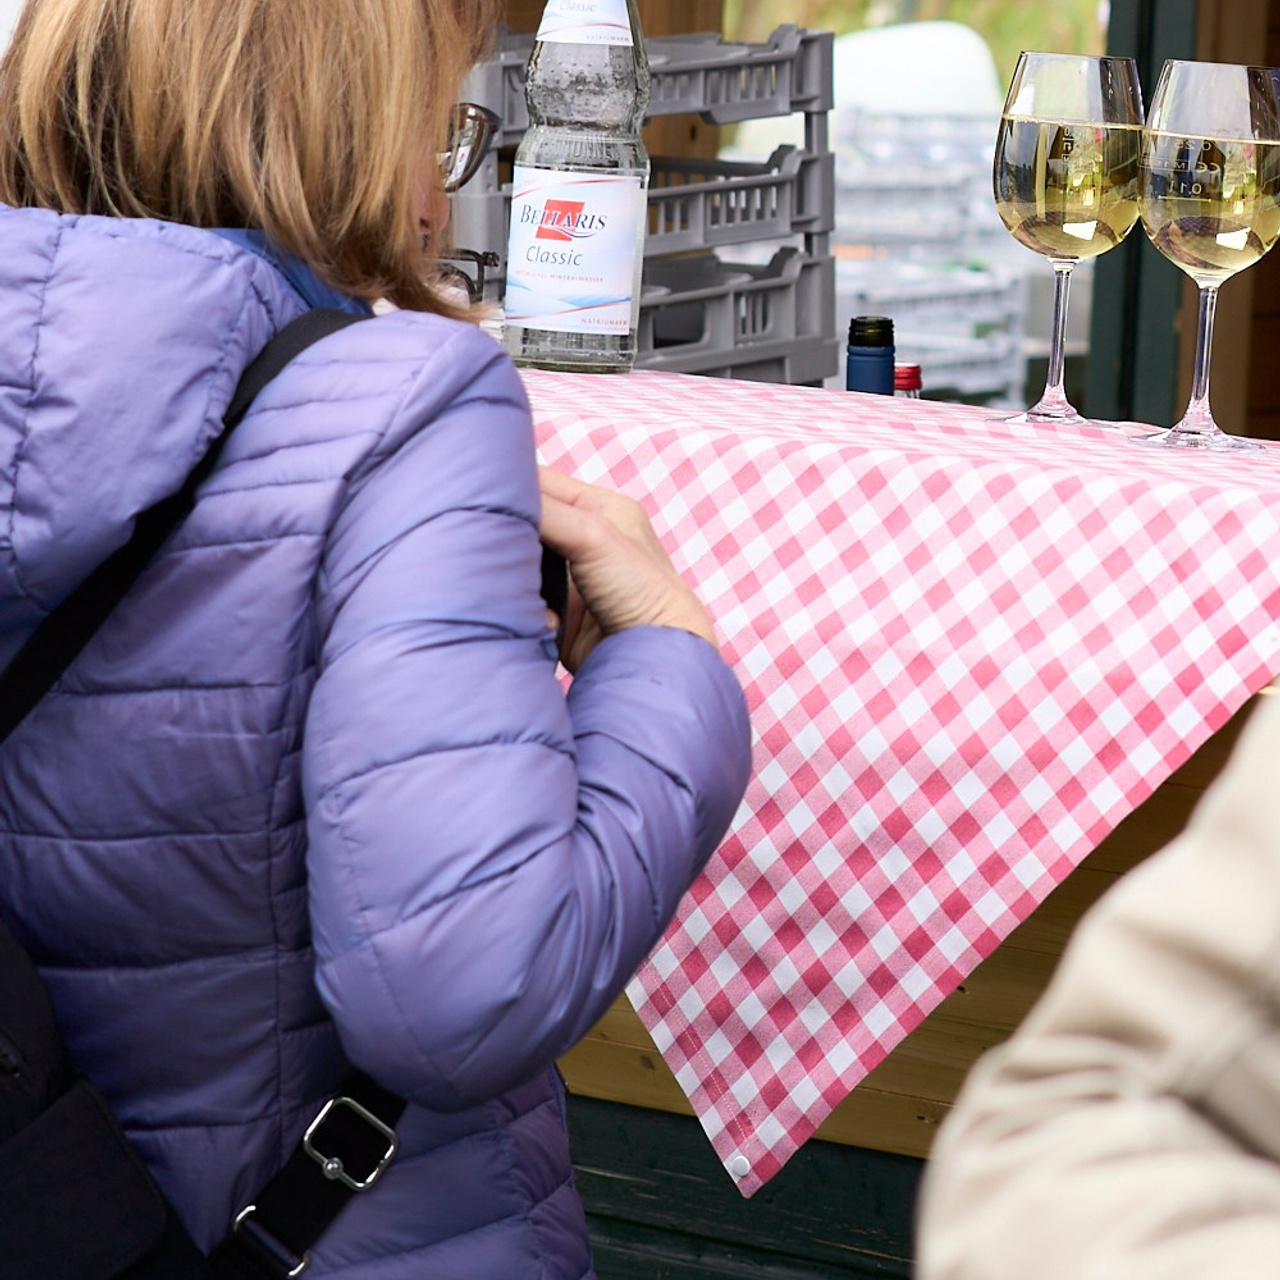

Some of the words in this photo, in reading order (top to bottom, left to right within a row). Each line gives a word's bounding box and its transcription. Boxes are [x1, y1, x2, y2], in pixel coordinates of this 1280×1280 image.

[560, 0, 597, 13] Classic
[520, 204, 607, 230] BELLARIS
[525, 244, 583, 267] Classic
